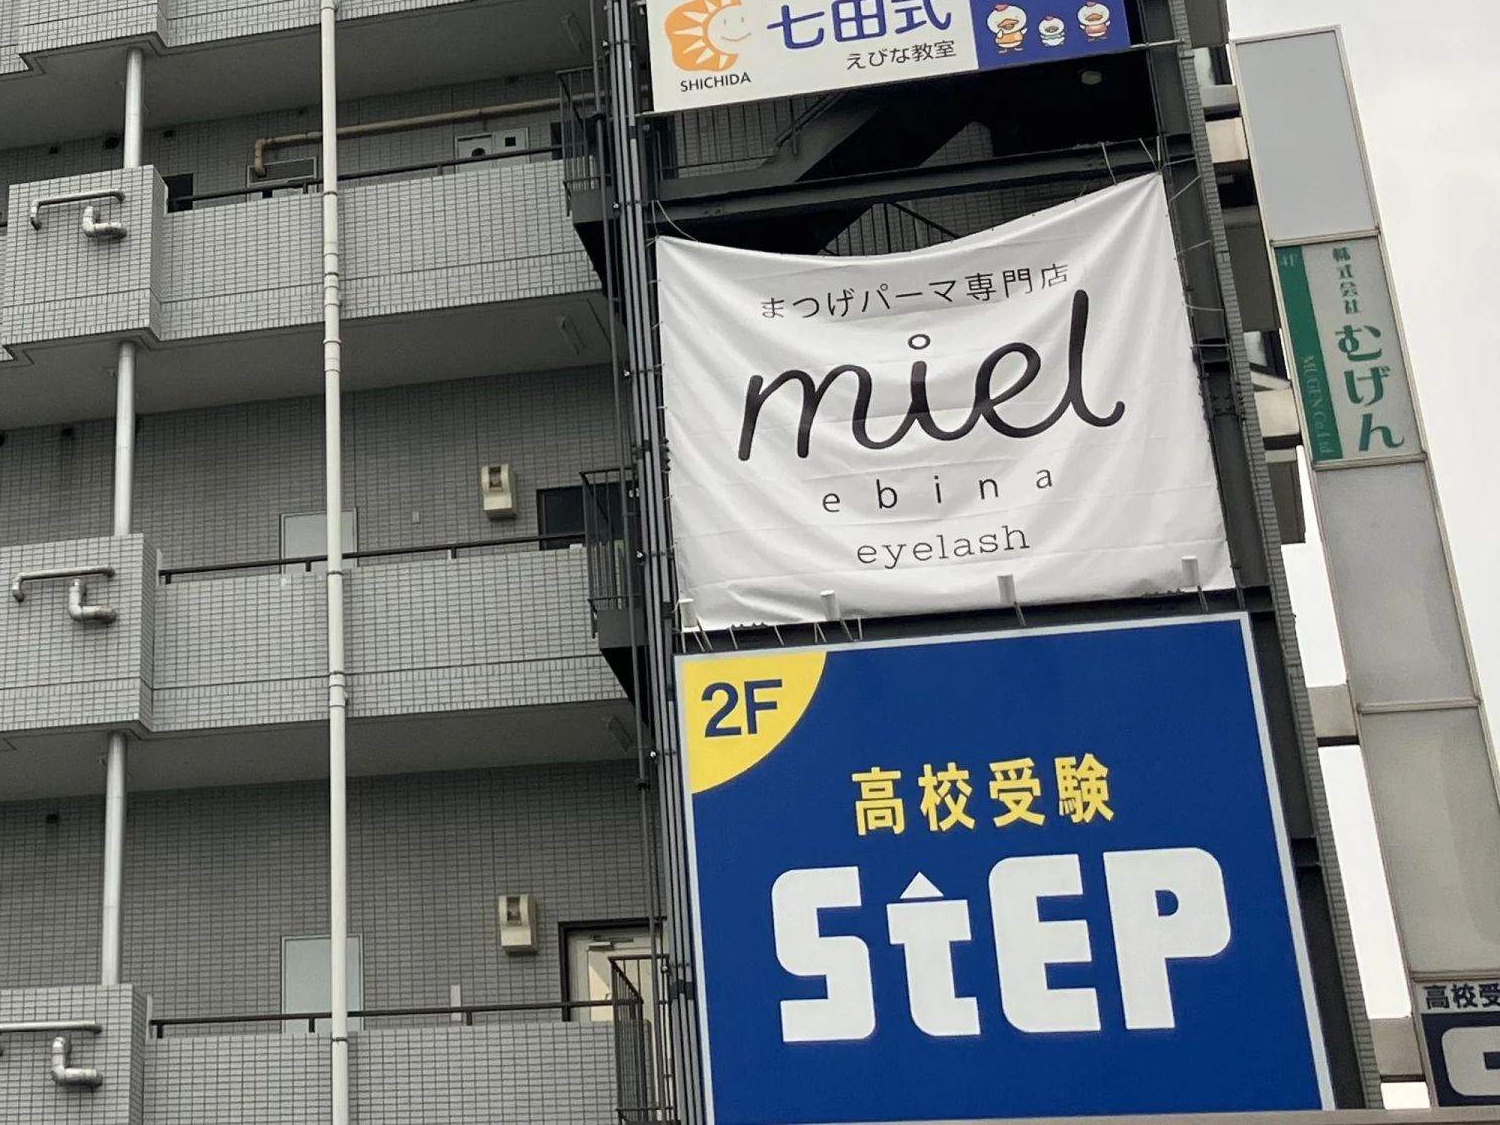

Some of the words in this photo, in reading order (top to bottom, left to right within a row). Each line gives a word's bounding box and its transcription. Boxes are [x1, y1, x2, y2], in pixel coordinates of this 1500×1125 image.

[680, 72, 752, 93] SHICHIDA
[846, 39, 957, 71] えびな教室
[760, 263, 1070, 319] まつげパーマ専門店
[737, 288, 1126, 462] miel
[1334, 324, 1405, 452] むげん
[856, 525, 1031, 569] eyelash
[700, 678, 784, 738] 2F
[851, 752, 1115, 836] 高校受験
